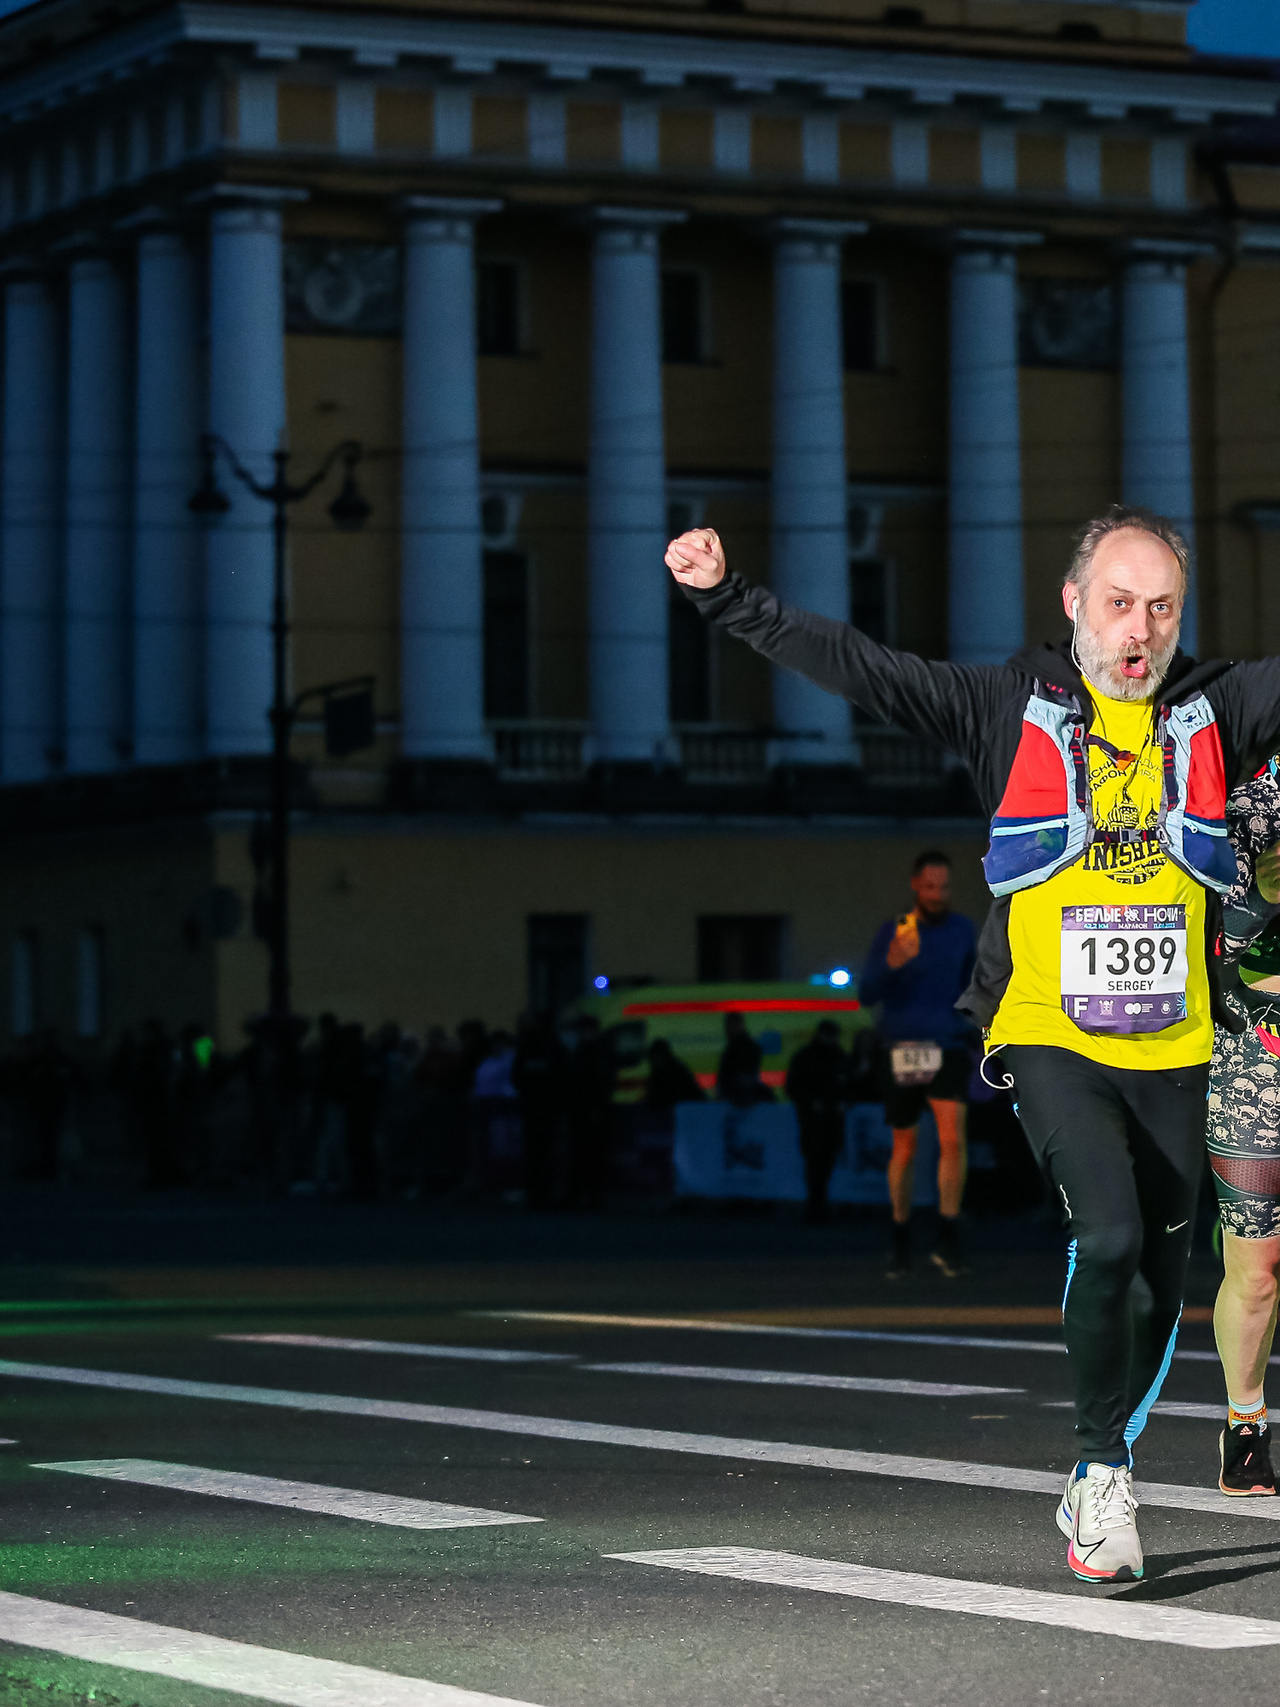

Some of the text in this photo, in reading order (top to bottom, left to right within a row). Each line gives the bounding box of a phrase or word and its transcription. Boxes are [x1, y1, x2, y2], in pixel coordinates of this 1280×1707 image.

[1083, 840, 1161, 871] INISHE
[1075, 907, 1178, 922] БЕЛЫЕ НОЧИ
[1081, 937, 1177, 975] 1389
[1107, 980, 1154, 991] SERGEY
[1073, 996, 1089, 1019] F
